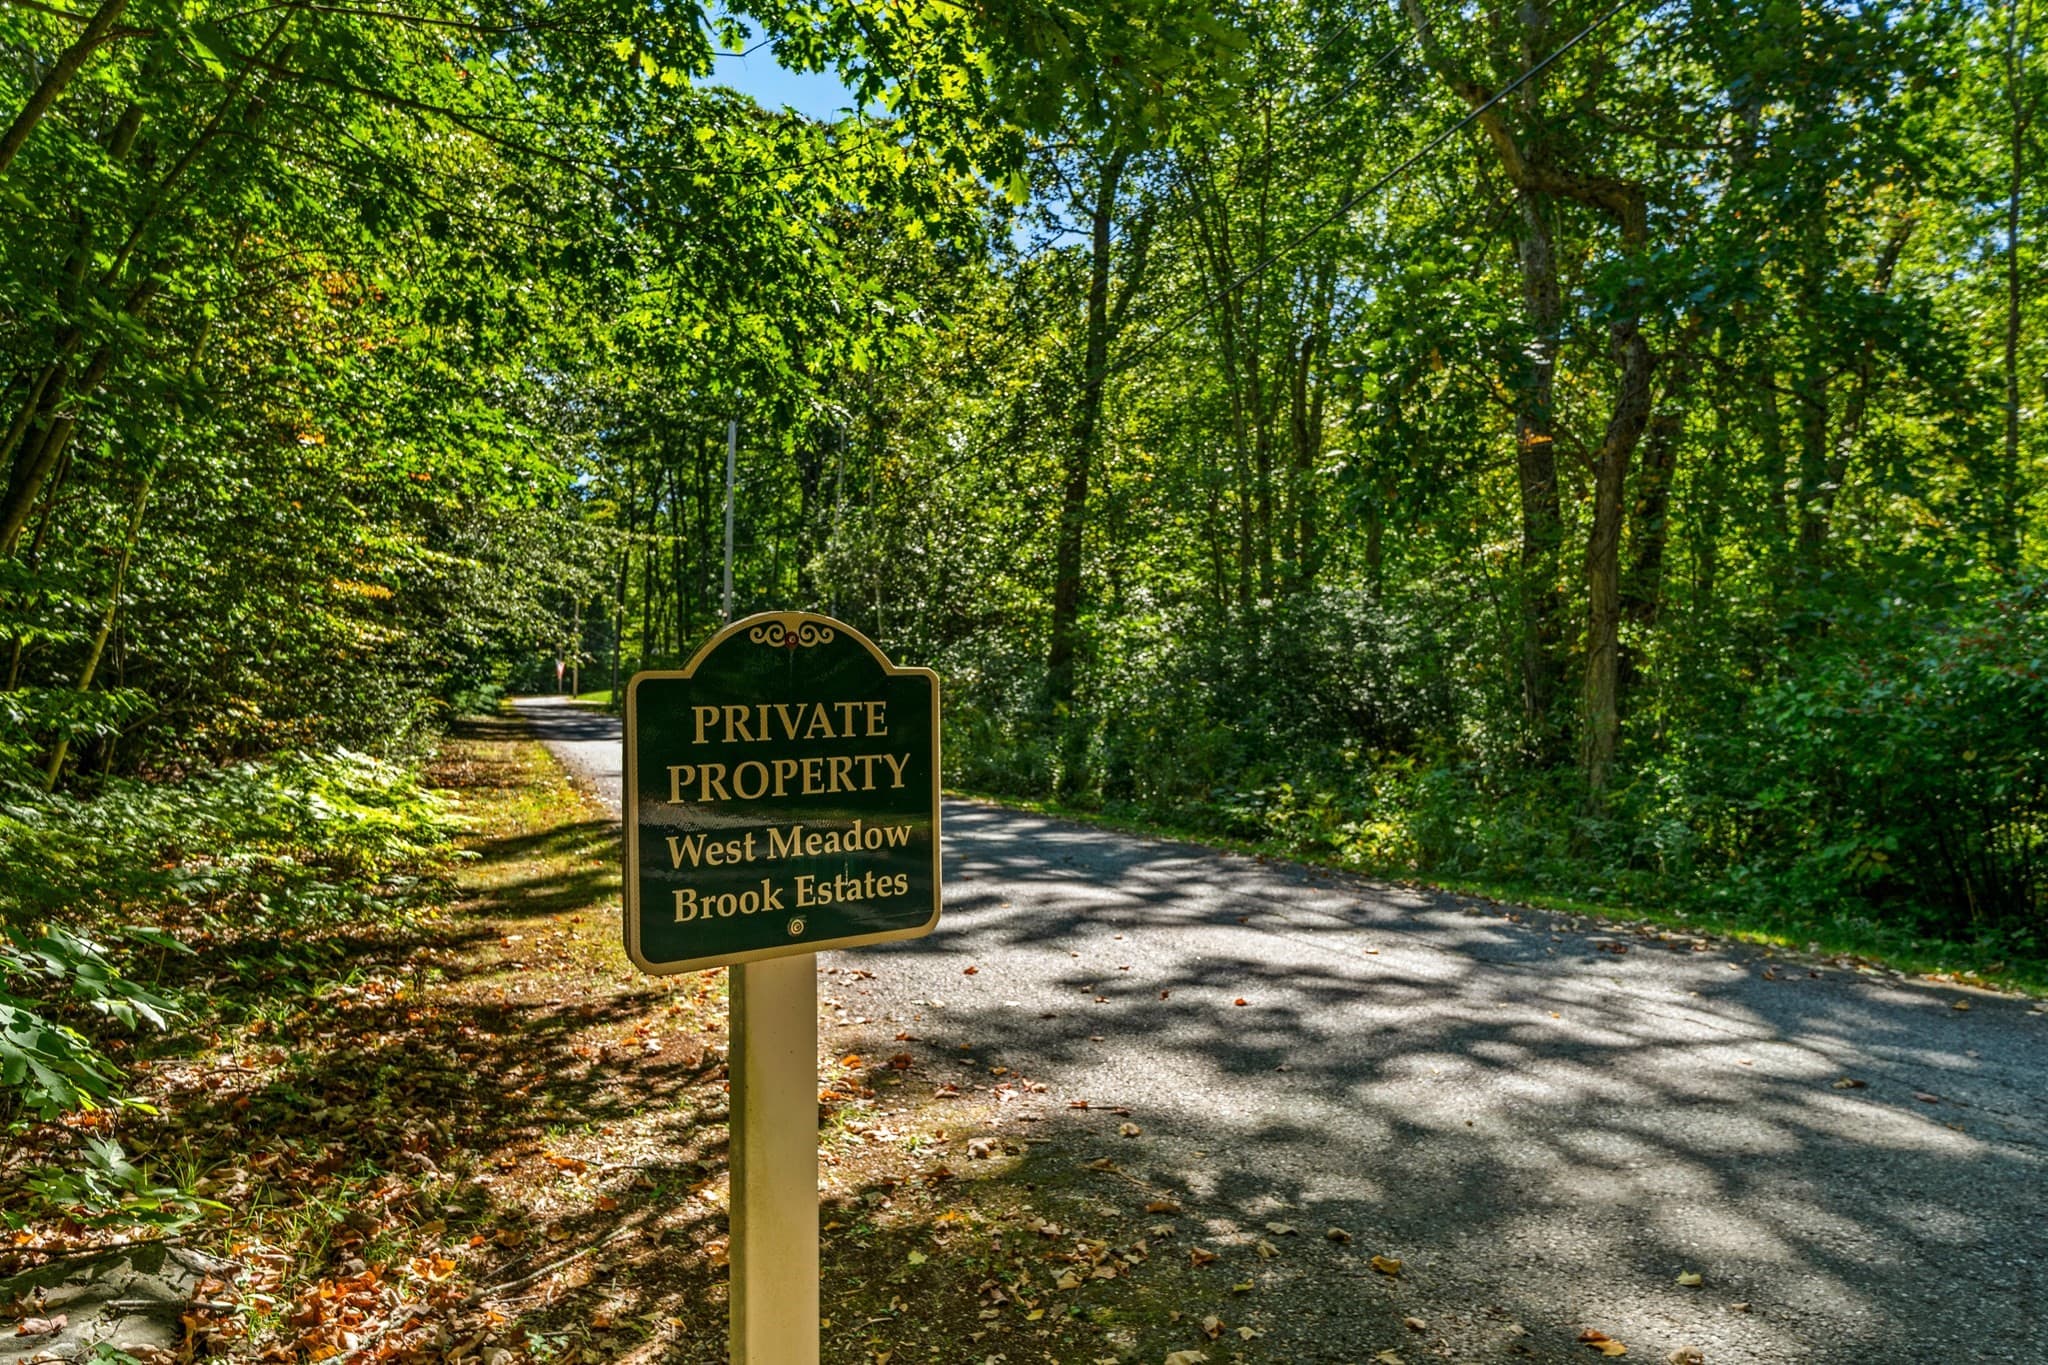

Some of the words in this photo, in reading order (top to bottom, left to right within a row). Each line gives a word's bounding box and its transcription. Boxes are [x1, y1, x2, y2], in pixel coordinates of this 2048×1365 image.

[691, 701, 888, 744] PRIVATE
[666, 753, 911, 804] PROPERTY
[666, 831, 756, 869] West
[766, 820, 913, 860] Meadow
[672, 879, 784, 922] Brook
[794, 873, 909, 907] Estates
